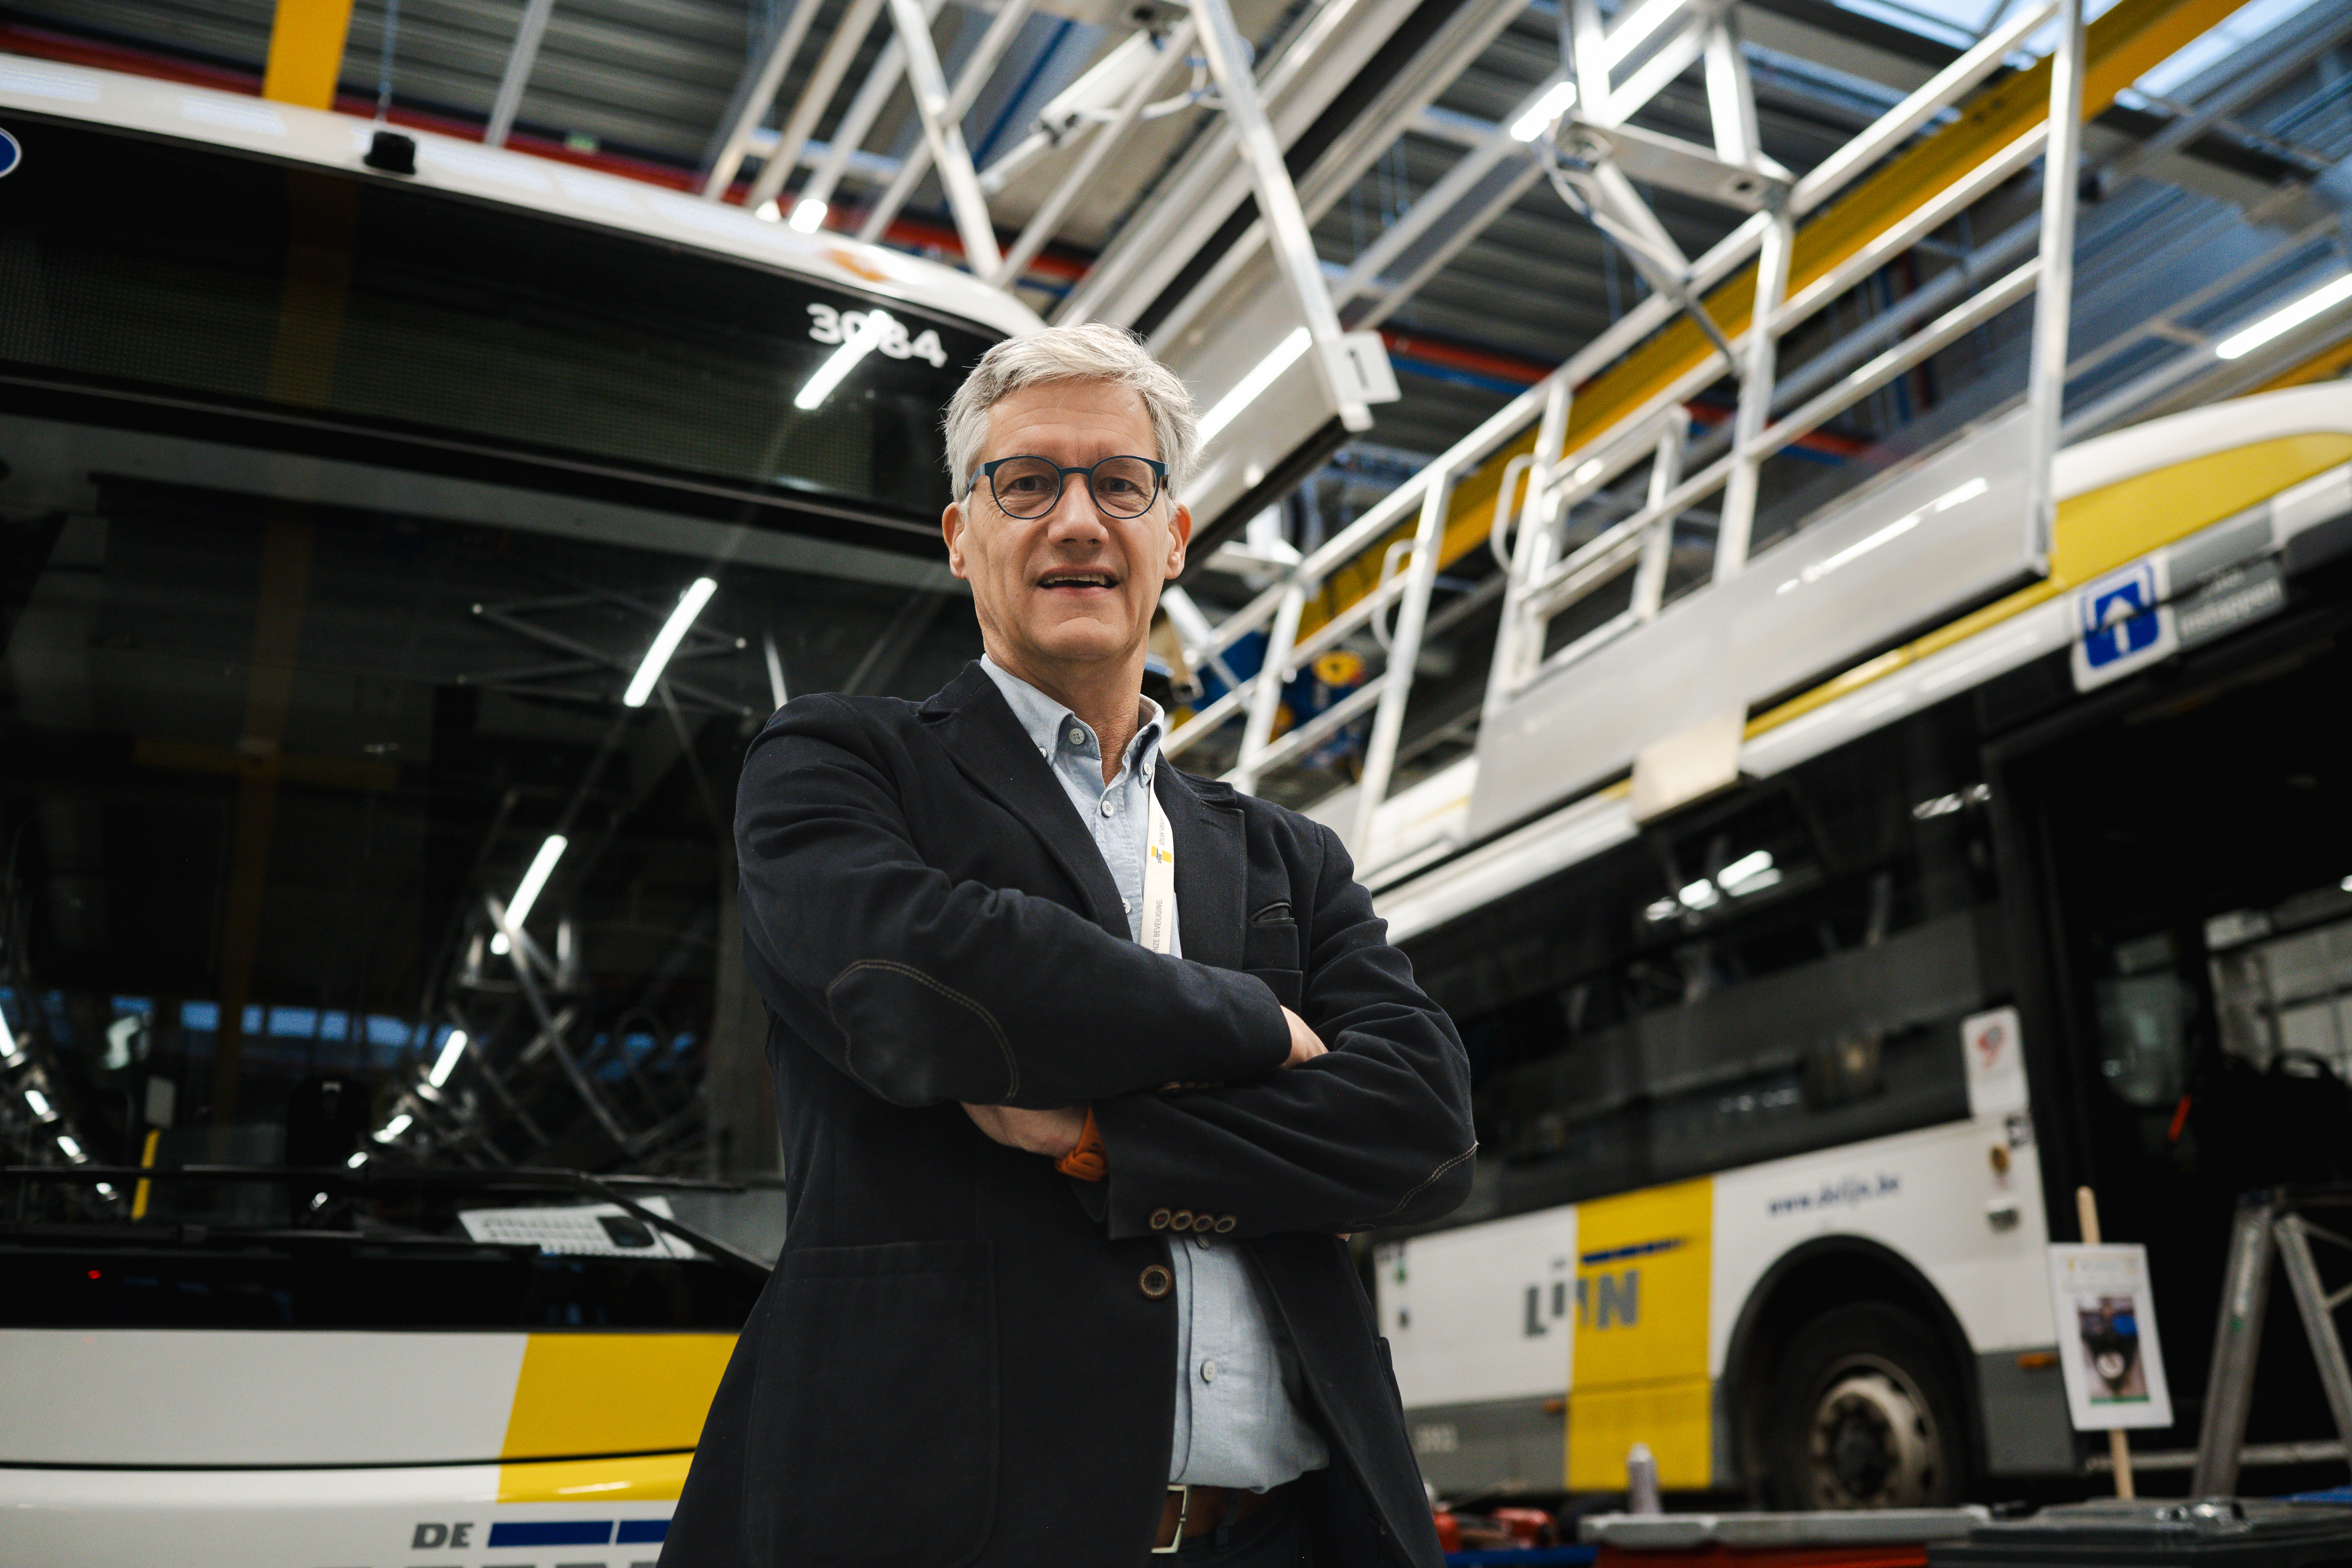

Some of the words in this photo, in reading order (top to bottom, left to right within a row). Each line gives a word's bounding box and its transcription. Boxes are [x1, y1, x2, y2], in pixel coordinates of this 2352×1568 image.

[806, 303, 947, 368] 3084
[1347, 348, 1369, 390] 1
[1154, 899, 1163, 937] BEVEILIGING.
[411, 1522, 474, 1549] DE
